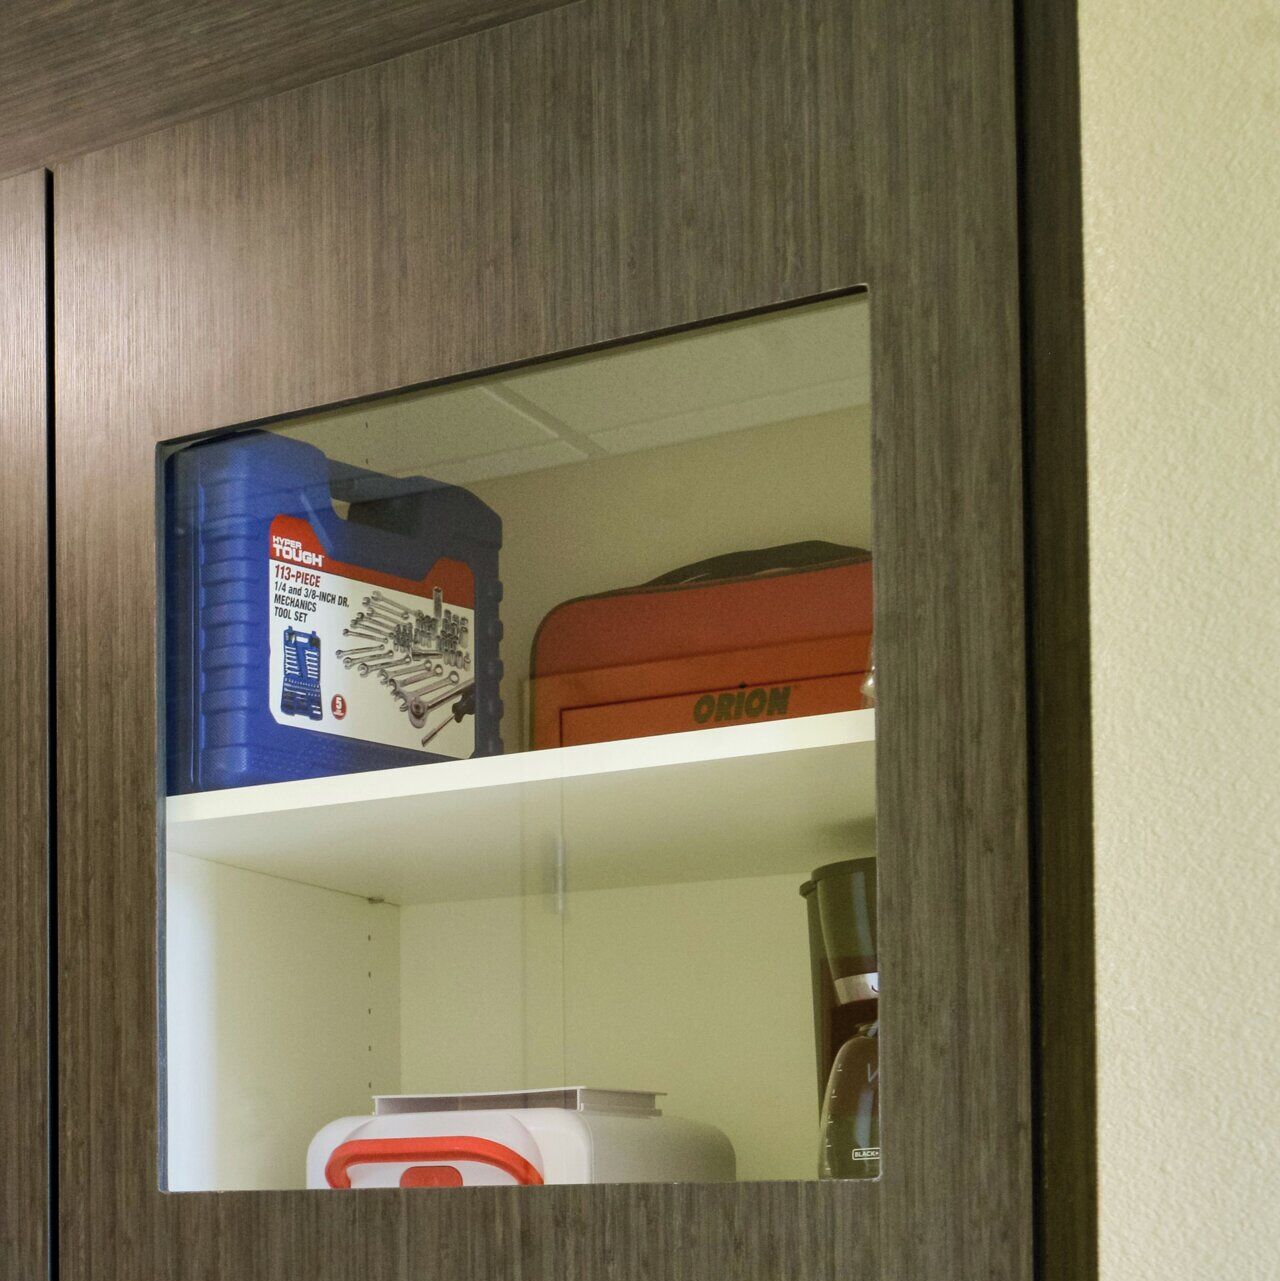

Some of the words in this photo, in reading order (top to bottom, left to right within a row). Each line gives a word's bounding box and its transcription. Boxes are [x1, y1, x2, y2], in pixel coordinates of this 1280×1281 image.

[272, 535, 302, 549] HYPER
[272, 543, 323, 567] TOUGH
[274, 564, 321, 588] 113-PIECE
[274, 581, 287, 593] 1/4
[288, 585, 303, 597] and
[303, 587, 337, 605] 3/8-INCH
[337, 595, 350, 608] DR.
[274, 593, 318, 613] MECHANICS
[274, 606, 292, 620] TOOL
[293, 610, 309, 624] SET
[693, 685, 792, 724] ORION
